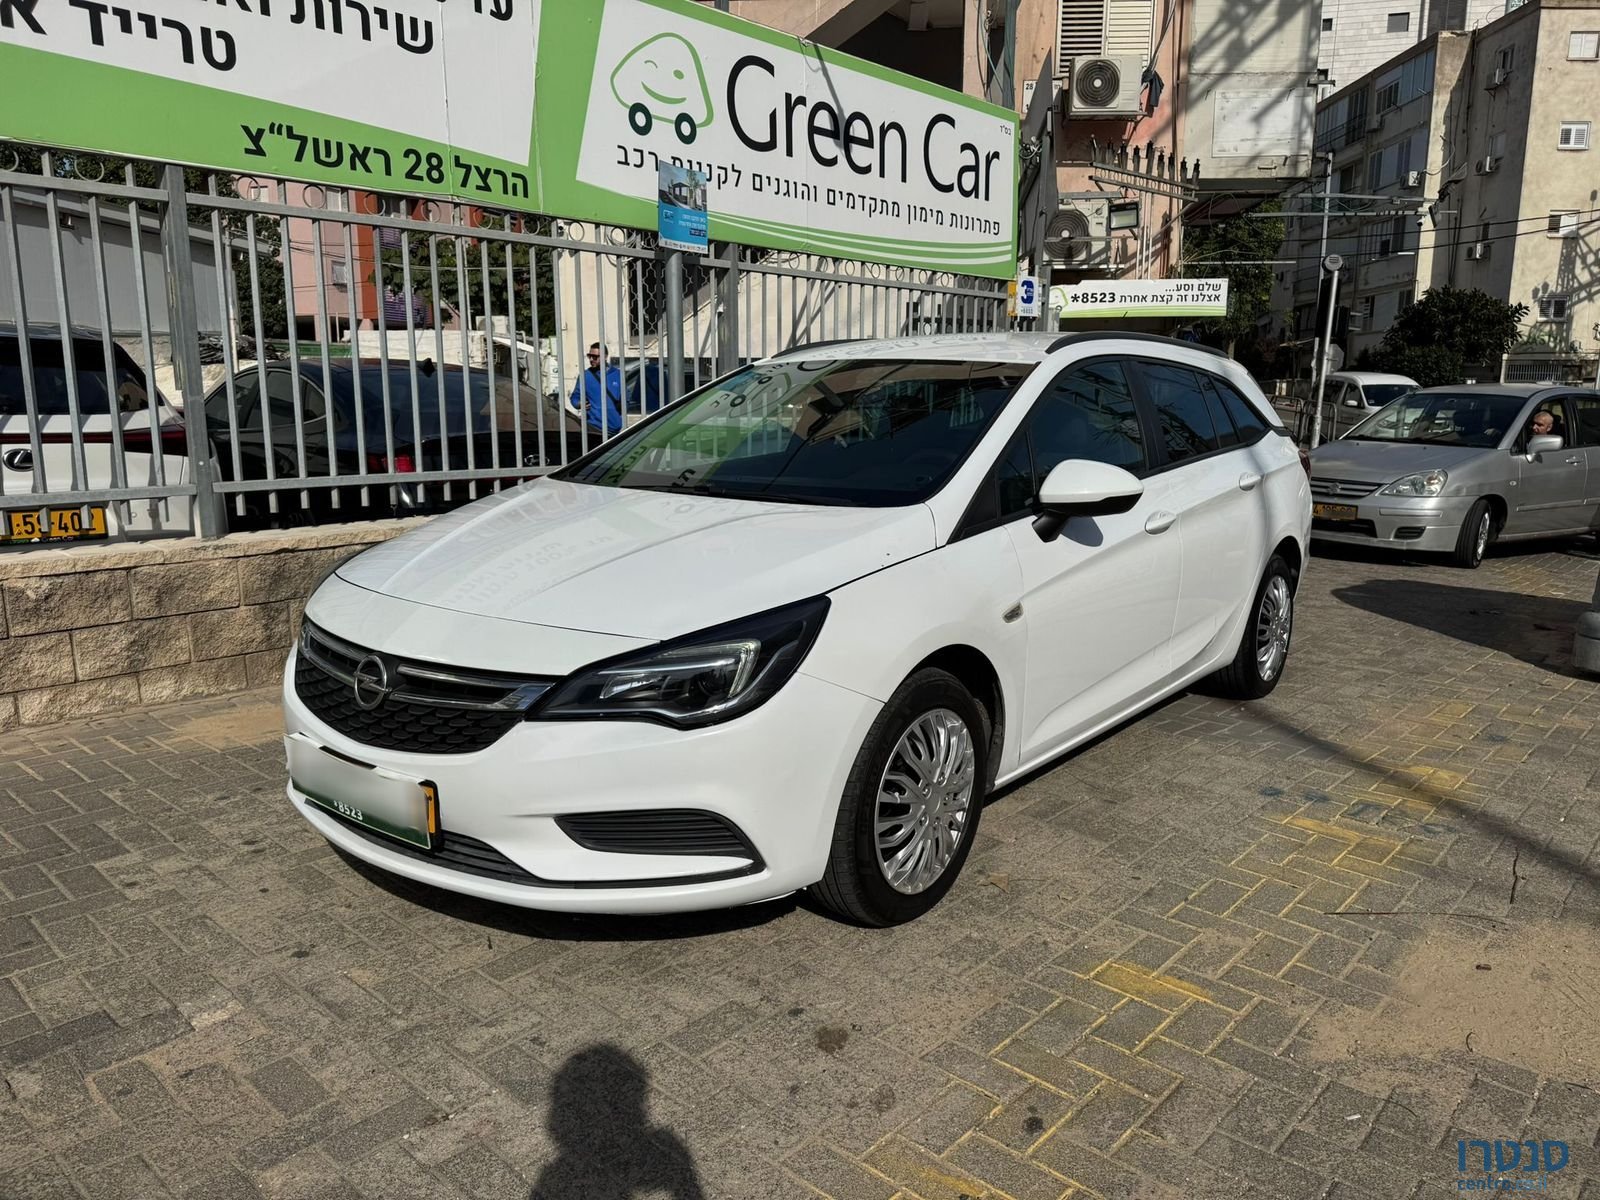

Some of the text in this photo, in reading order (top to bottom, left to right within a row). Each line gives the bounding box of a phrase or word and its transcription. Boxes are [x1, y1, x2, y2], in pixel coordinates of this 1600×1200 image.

[69, 0, 237, 72] טרייד
[727, 55, 1000, 202] Green Car
[403, 147, 445, 184] 28
[616, 144, 659, 172] רכב
[454, 154, 529, 199] הרצל
[752, 172, 818, 202] והוגנים
[826, 188, 900, 218] מתקדמים
[906, 204, 944, 225] מימון
[949, 212, 1000, 236] פתרונות
[1119, 294, 1148, 303] אחרת
[1151, 294, 1173, 304] קצת
[1165, 282, 1222, 292] שלם וסע...
[1176, 293, 1188, 303] זה
[1191, 292, 1221, 302] אצלנו
